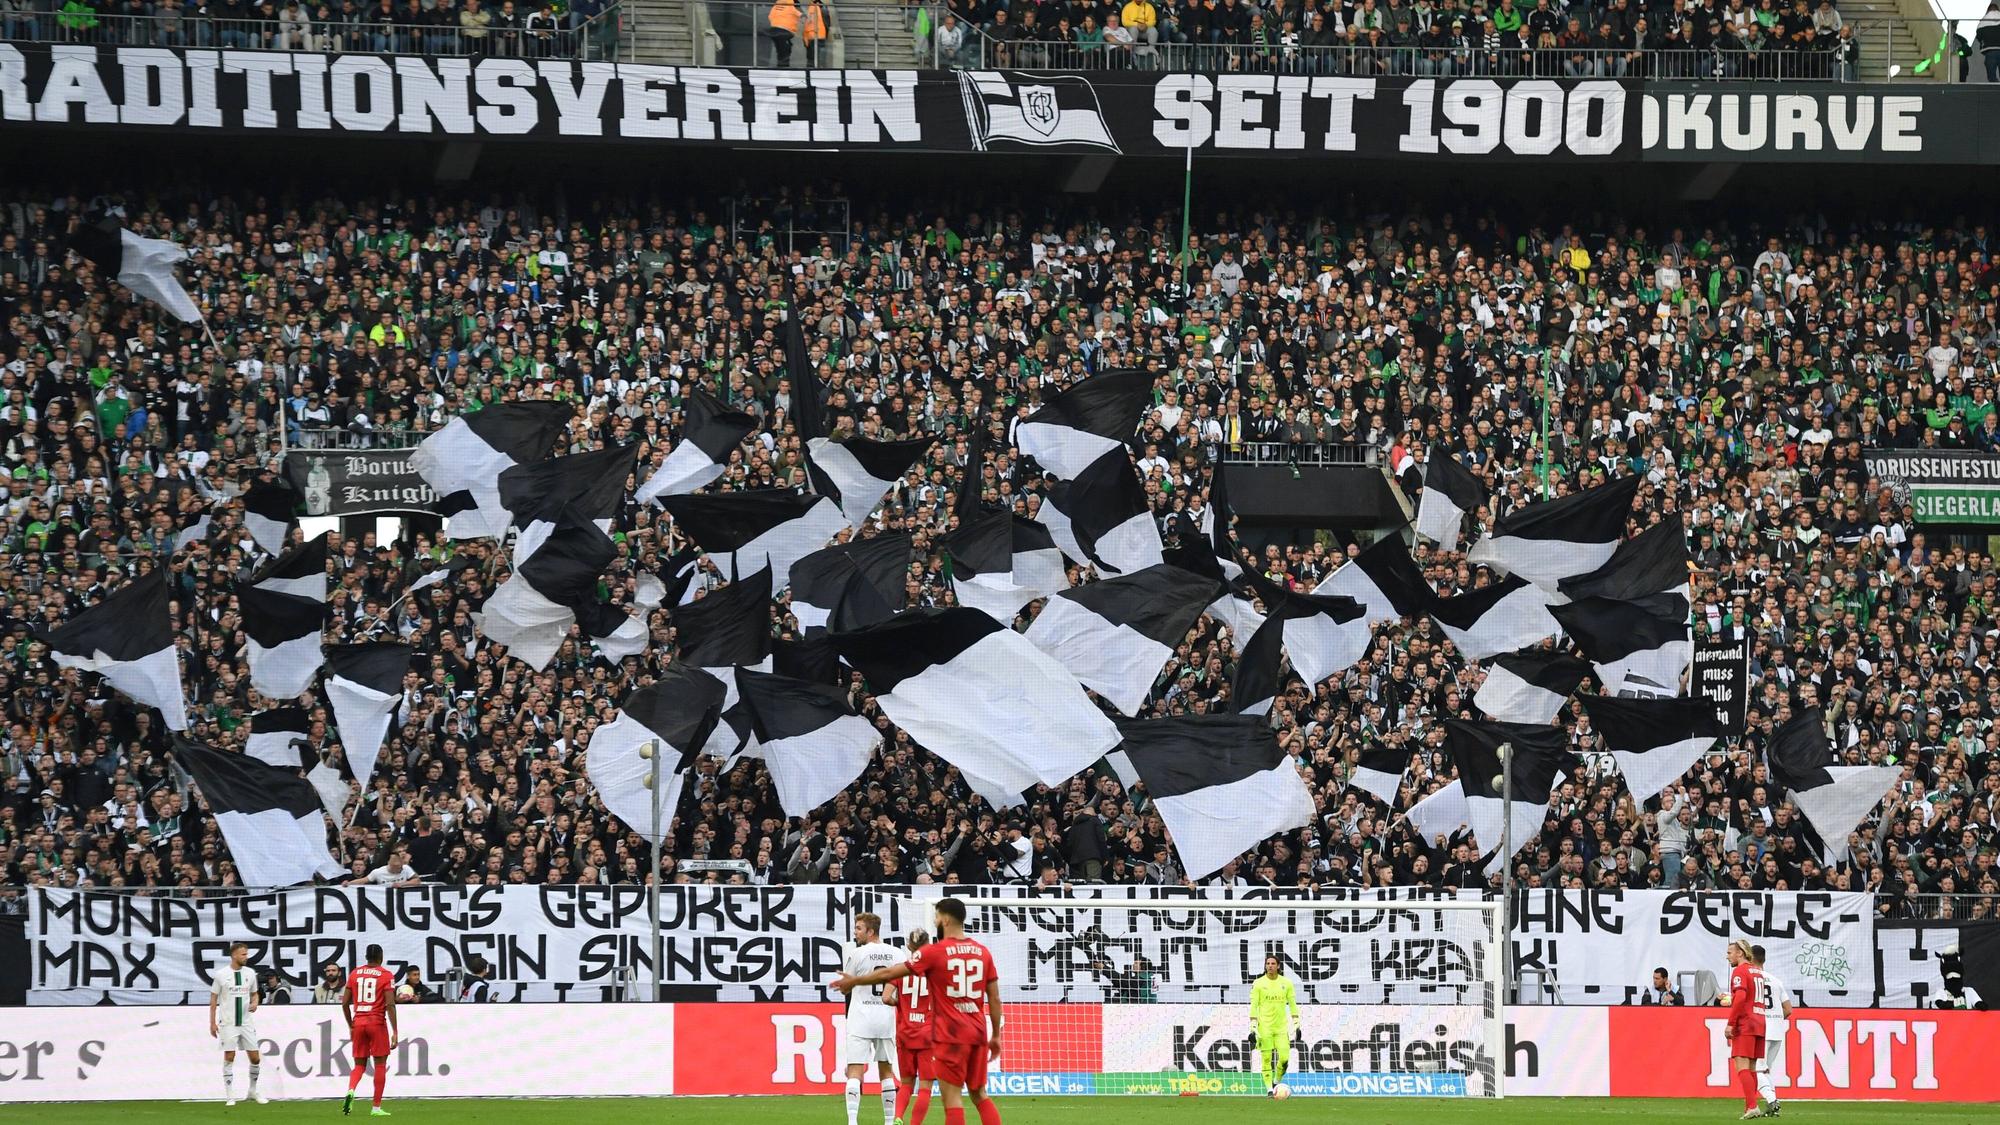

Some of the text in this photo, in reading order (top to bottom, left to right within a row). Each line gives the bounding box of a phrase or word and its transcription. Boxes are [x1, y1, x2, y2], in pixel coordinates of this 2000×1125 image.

[1152, 74, 1376, 151] SEIT
[1400, 79, 1626, 155] 1900
[342, 484, 440, 505] Knigh
[1695, 644, 1743, 663] niemand
[1703, 668, 1734, 681] muss
[39, 886, 503, 938] MONATELANGES
[541, 886, 796, 932] GEPOKER
[39, 940, 159, 989] MAX
[1371, 939, 1558, 983] KRAK!
[356, 976, 377, 1003] 18
[946, 958, 983, 999] 32
[1330, 1075, 1431, 1094] JONGEN
